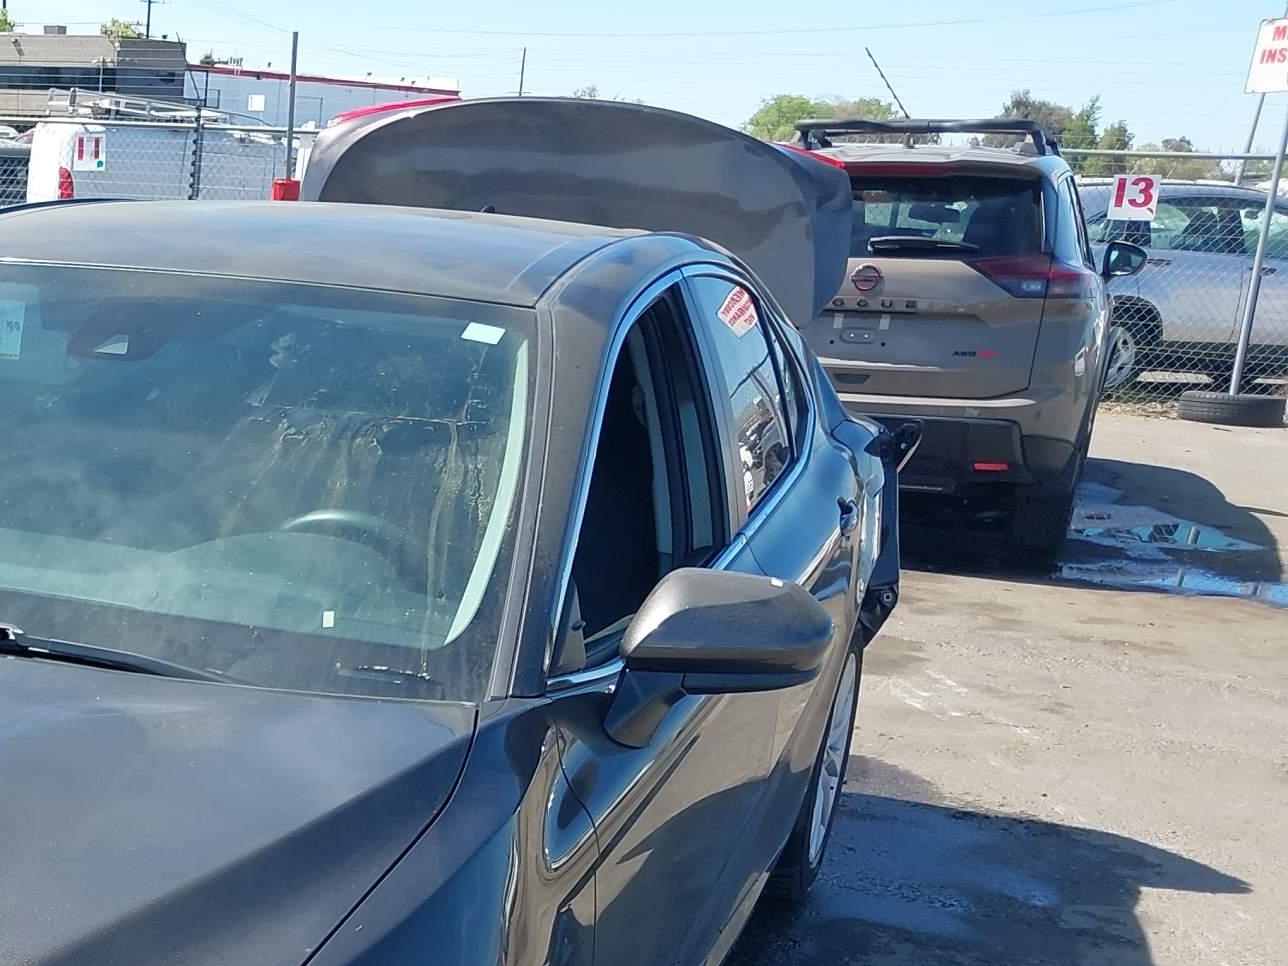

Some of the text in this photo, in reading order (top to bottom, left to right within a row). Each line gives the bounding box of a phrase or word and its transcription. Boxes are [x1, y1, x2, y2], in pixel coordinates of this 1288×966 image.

[1272, 25, 1288, 41] M
[1260, 47, 1288, 64] INS
[77, 136, 100, 161] 11
[1113, 177, 1155, 208] 13
[831, 297, 918, 309] OGUE
